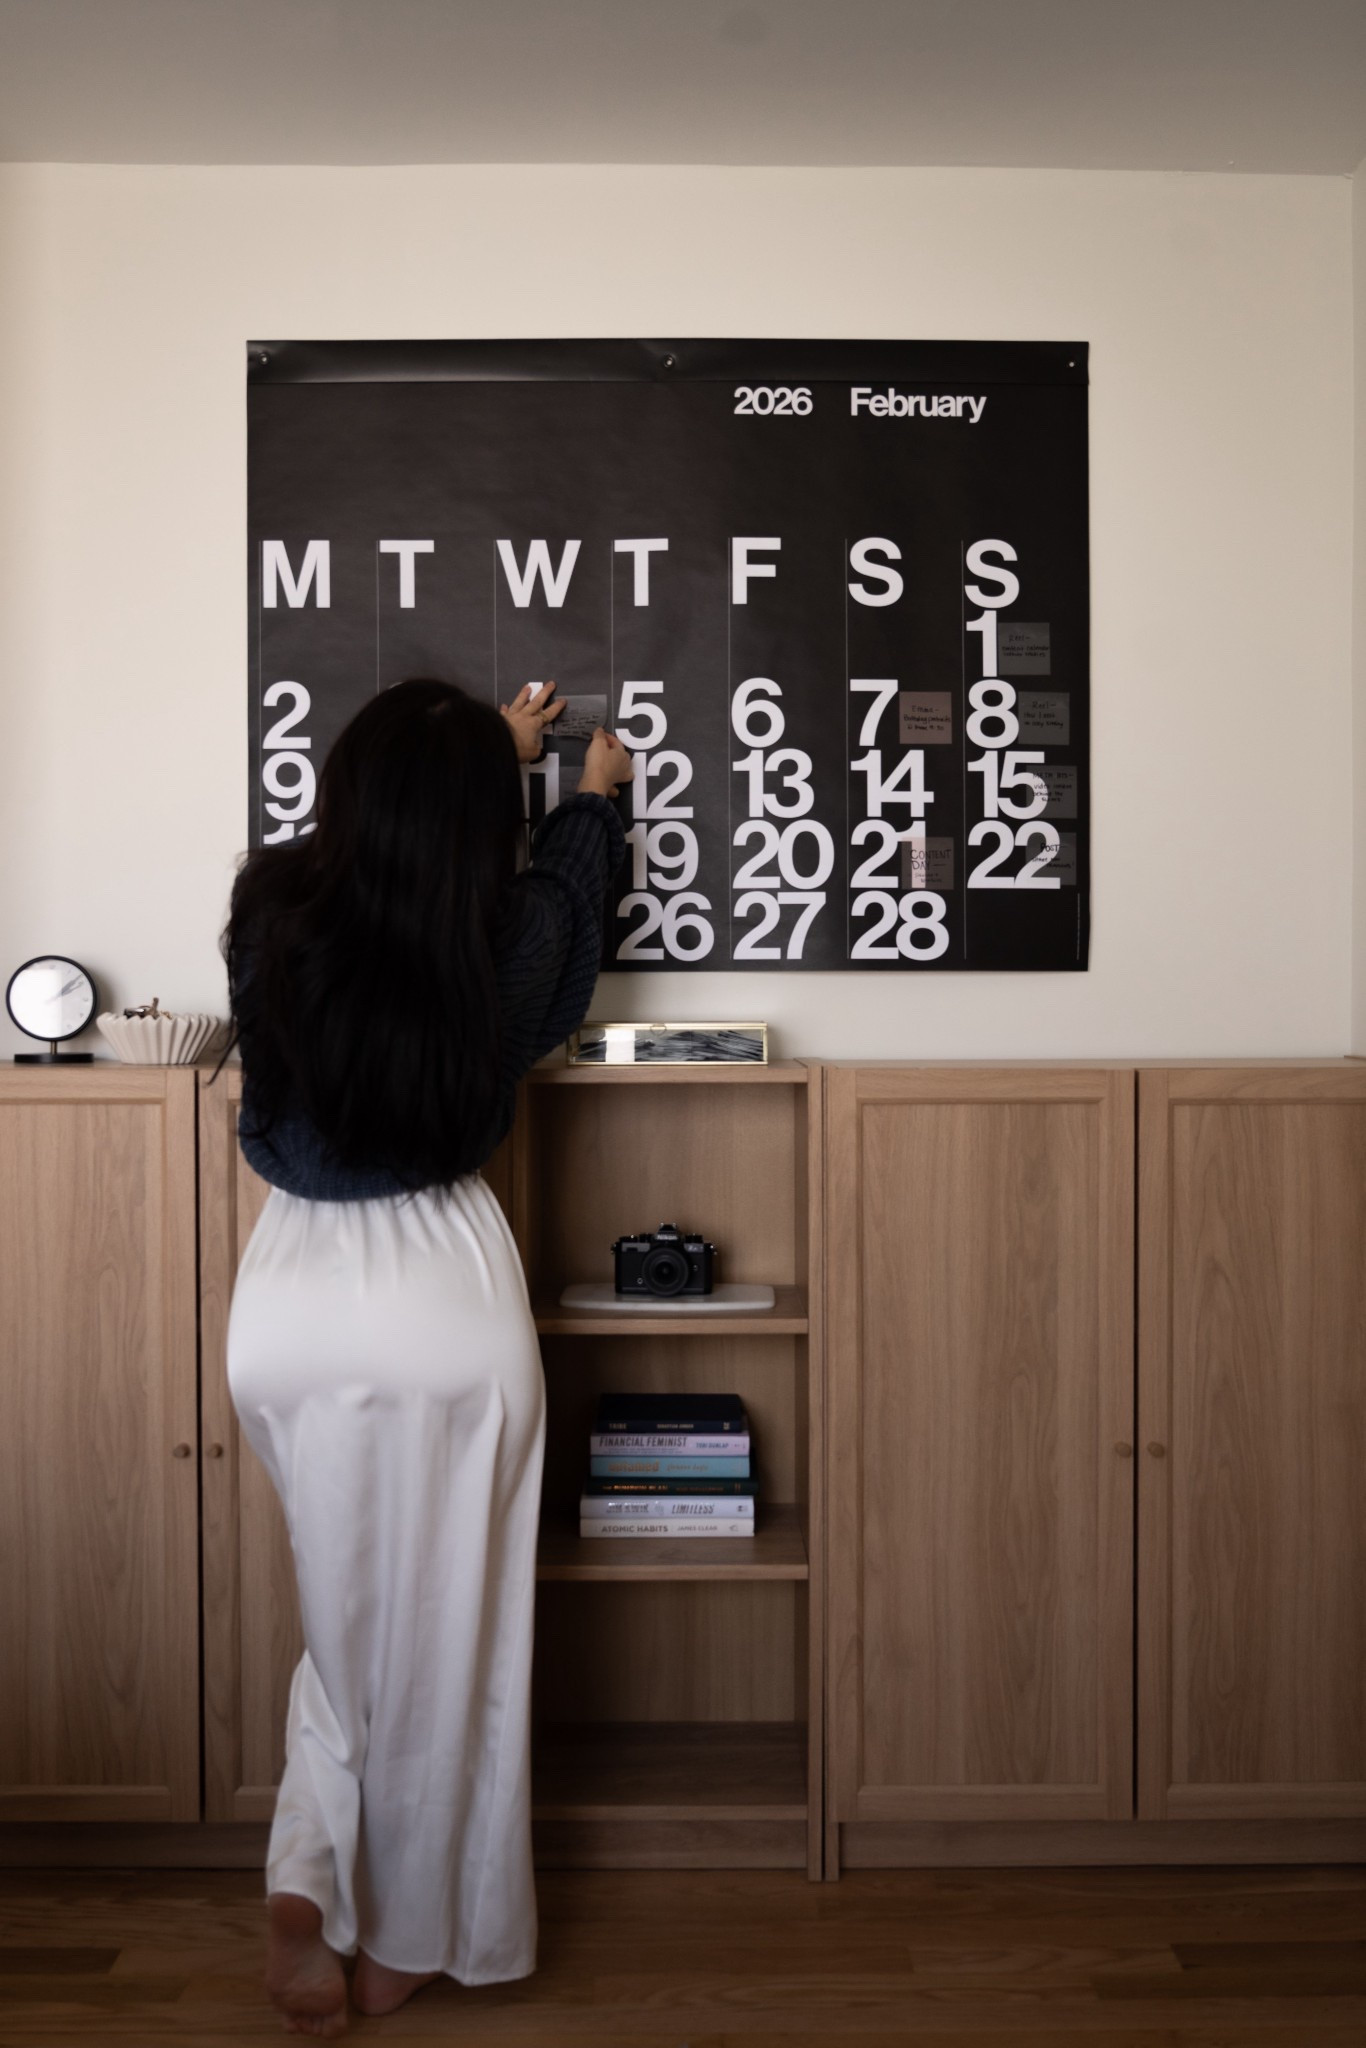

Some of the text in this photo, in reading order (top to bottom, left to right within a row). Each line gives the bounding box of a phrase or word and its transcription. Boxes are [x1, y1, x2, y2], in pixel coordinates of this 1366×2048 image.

[733, 387, 987, 424] 2026 February
[262, 537, 1020, 608] M T W T F S S
[966, 610, 997, 678] 1
[262, 681, 312, 749] 2
[614, 681, 668, 750] 5
[732, 678, 785, 748] 6
[849, 679, 899, 747] 7
[966, 679, 1020, 749] 8
[262, 751, 317, 821] 9
[631, 750, 694, 819] 12
[732, 749, 815, 818] 13
[850, 750, 935, 818] 14
[967, 751, 1049, 820] 15
[624, 820, 1061, 890] 19 20 21 22
[616, 891, 950, 961] 26 27 28
[600, 1437, 645, 1448] FINANCIAL
[646, 1437, 688, 1448] FEMINIST
[602, 1525, 634, 1533] ATOMIC
[637, 1525, 669, 1533] HABITS
[671, 1504, 715, 1515] LIMITLESS
